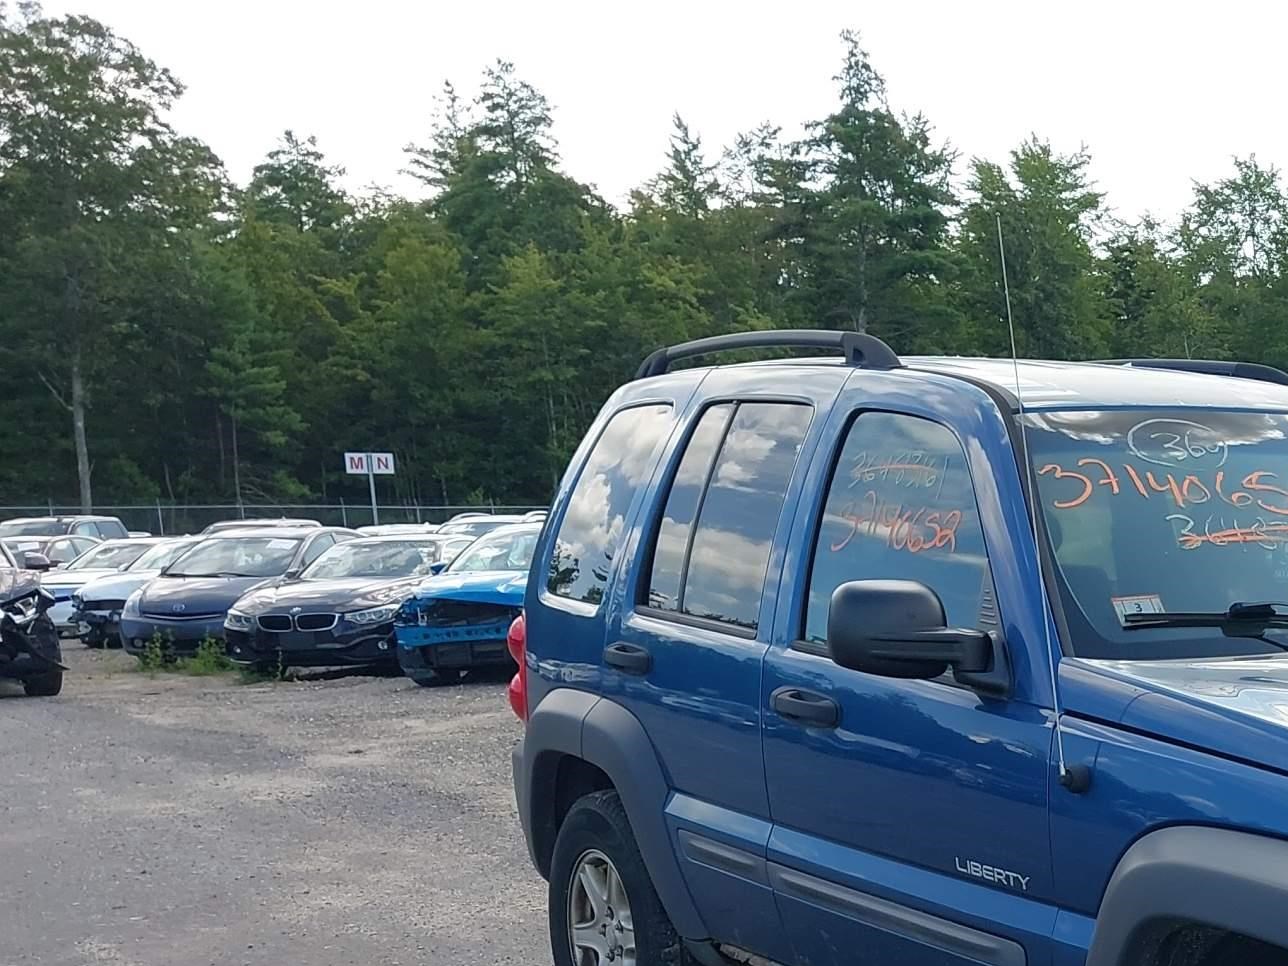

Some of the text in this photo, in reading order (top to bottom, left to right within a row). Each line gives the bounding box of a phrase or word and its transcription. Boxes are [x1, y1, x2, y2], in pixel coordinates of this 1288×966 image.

[350, 456, 363, 470] M
[376, 456, 389, 470] N
[954, 855, 1031, 891] LIBERTY
